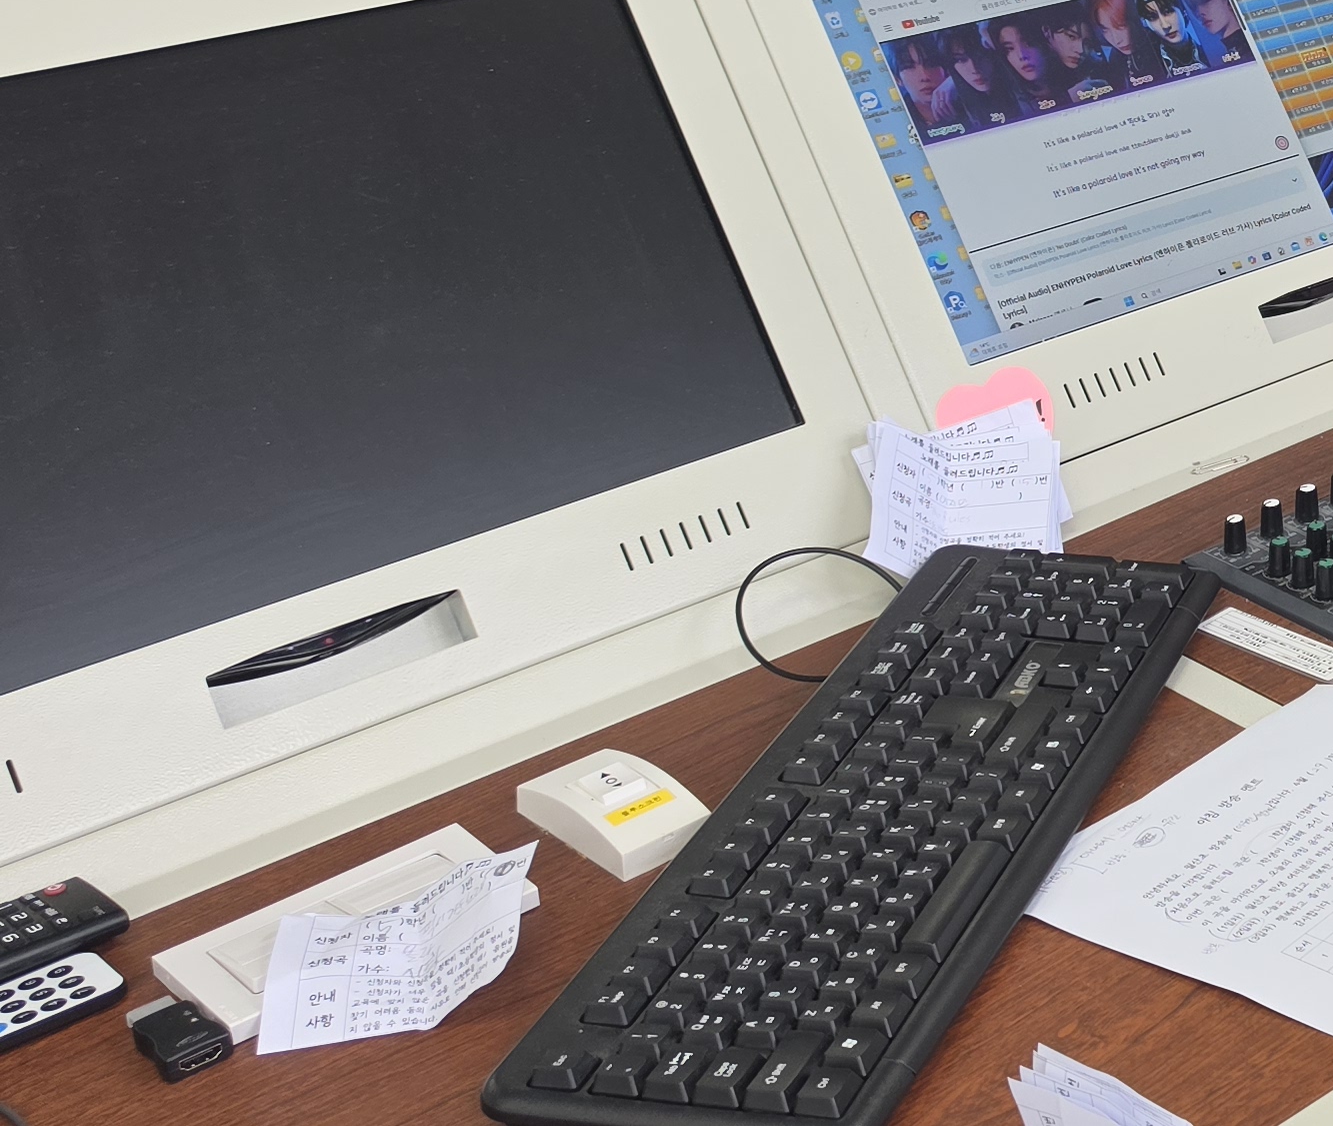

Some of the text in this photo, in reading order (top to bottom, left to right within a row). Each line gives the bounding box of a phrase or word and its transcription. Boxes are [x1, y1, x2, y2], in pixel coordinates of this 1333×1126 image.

[912, 12, 941, 27] YouTube
[1043, 139, 1056, 149] It's
[1056, 137, 1069, 145] like
[1076, 126, 1103, 140] polaroid
[1118, 119, 1126, 127] 내
[1126, 114, 1148, 127] 뜻대로
[1146, 111, 1160, 119] 되지
[1161, 107, 1175, 118] 않아
[1052, 188, 1067, 199] It's
[1066, 185, 1081, 194] like
[1087, 173, 1118, 189] polaroid
[1117, 170, 1133, 180] love
[1133, 165, 1147, 175] It's
[1146, 162, 1159, 171] not
[1159, 157, 1180, 169] going
[1179, 153, 1191, 162] my
[1191, 150, 1205, 159] way
[997, 203, 1312, 309] [Official Audio] ENHYPEN Polaroid Love Lyrics (엔하이픈 폴라로이드 러브 가사) Lyrics [Color Coded
[1002, 304, 1028, 320] Lyrics]
[942, 465, 995, 478] 들려드립니다
[893, 518, 907, 533] 안내
[891, 535, 907, 550] 사항
[1197, 778, 1264, 825] 아침 방송 멘트
[1142, 873, 1185, 900] 안녕하세요.
[1183, 853, 1209, 870] 월산초
[1208, 834, 1233, 851] 방송부
[1154, 863, 1218, 908] 방송을 시작합니다.
[1201, 919, 1213, 927] 이
[1230, 878, 1269, 904] 마지막으로
[1268, 858, 1293, 878] 오늘의
[1291, 846, 1309, 858] 아침
[1307, 833, 1325, 846] 음악
[1244, 895, 1270, 910] 월산초
[1268, 880, 1288, 893] 학생
[1286, 857, 1317, 880] 여러분의
[1261, 900, 1286, 917] 오늘도
[1307, 863, 1333, 880] 행복한
[1169, 868, 1234, 915] 처음으로 들려드릴
[1185, 908, 1204, 921] 이번
[1275, 900, 1308, 922] 행복하고
[1293, 900, 1331, 927] 감사합니다.
[362, 933, 389, 943] 이름
[1295, 939, 1312, 953] 순서
[307, 944, 391, 968] 신청곡 곡명:
[357, 963, 390, 974] 가수:
[308, 988, 336, 1006] 안내
[305, 1013, 335, 1029] 사항
[386, 1019, 396, 1027] 수
[401, 1015, 438, 1025] 있습니다.
